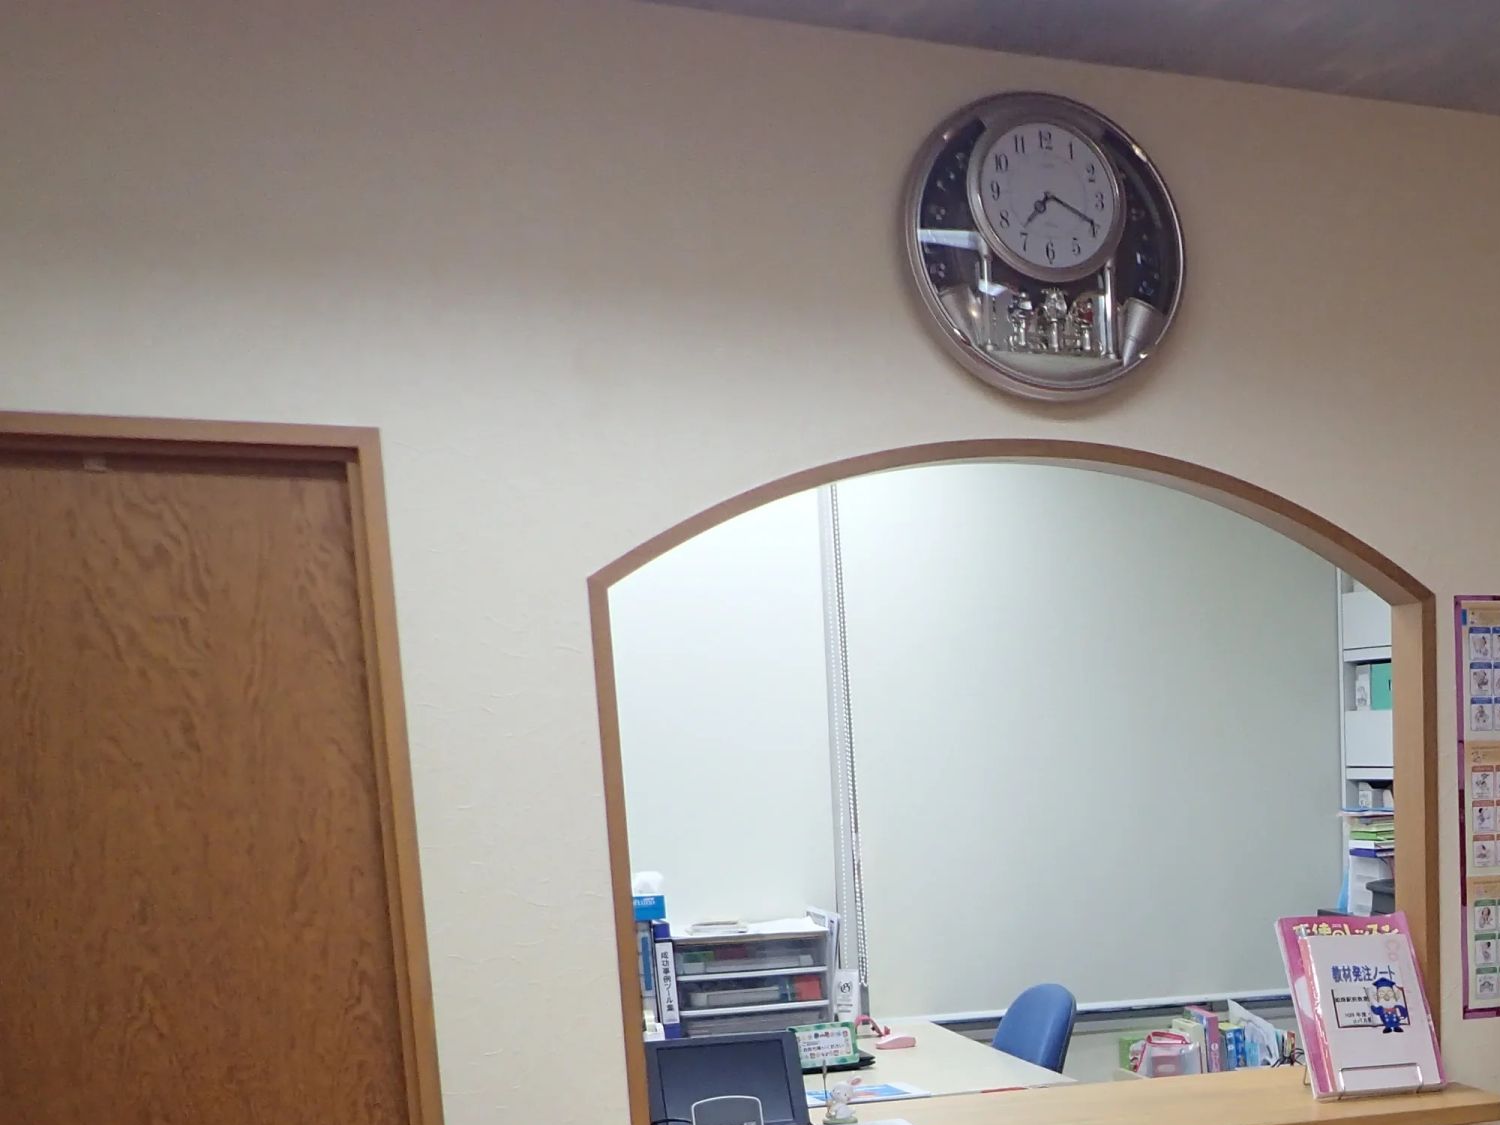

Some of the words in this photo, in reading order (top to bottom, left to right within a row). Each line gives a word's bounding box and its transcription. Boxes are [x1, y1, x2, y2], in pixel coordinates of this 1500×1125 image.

[1014, 135, 1026, 154] 11
[1038, 130, 1053, 150] 12
[1067, 142, 1075, 160] 1
[994, 154, 1009, 173] 10
[1086, 164, 1096, 184] 2
[990, 182, 1001, 200] 9
[1095, 192, 1105, 210] 3
[1000, 211, 1010, 229] 8
[1020, 232, 1031, 251] 7
[1072, 238, 1081, 256] 5
[1045, 243, 1056, 265] 6
[1331, 964, 1396, 983] 教材発注ノート
